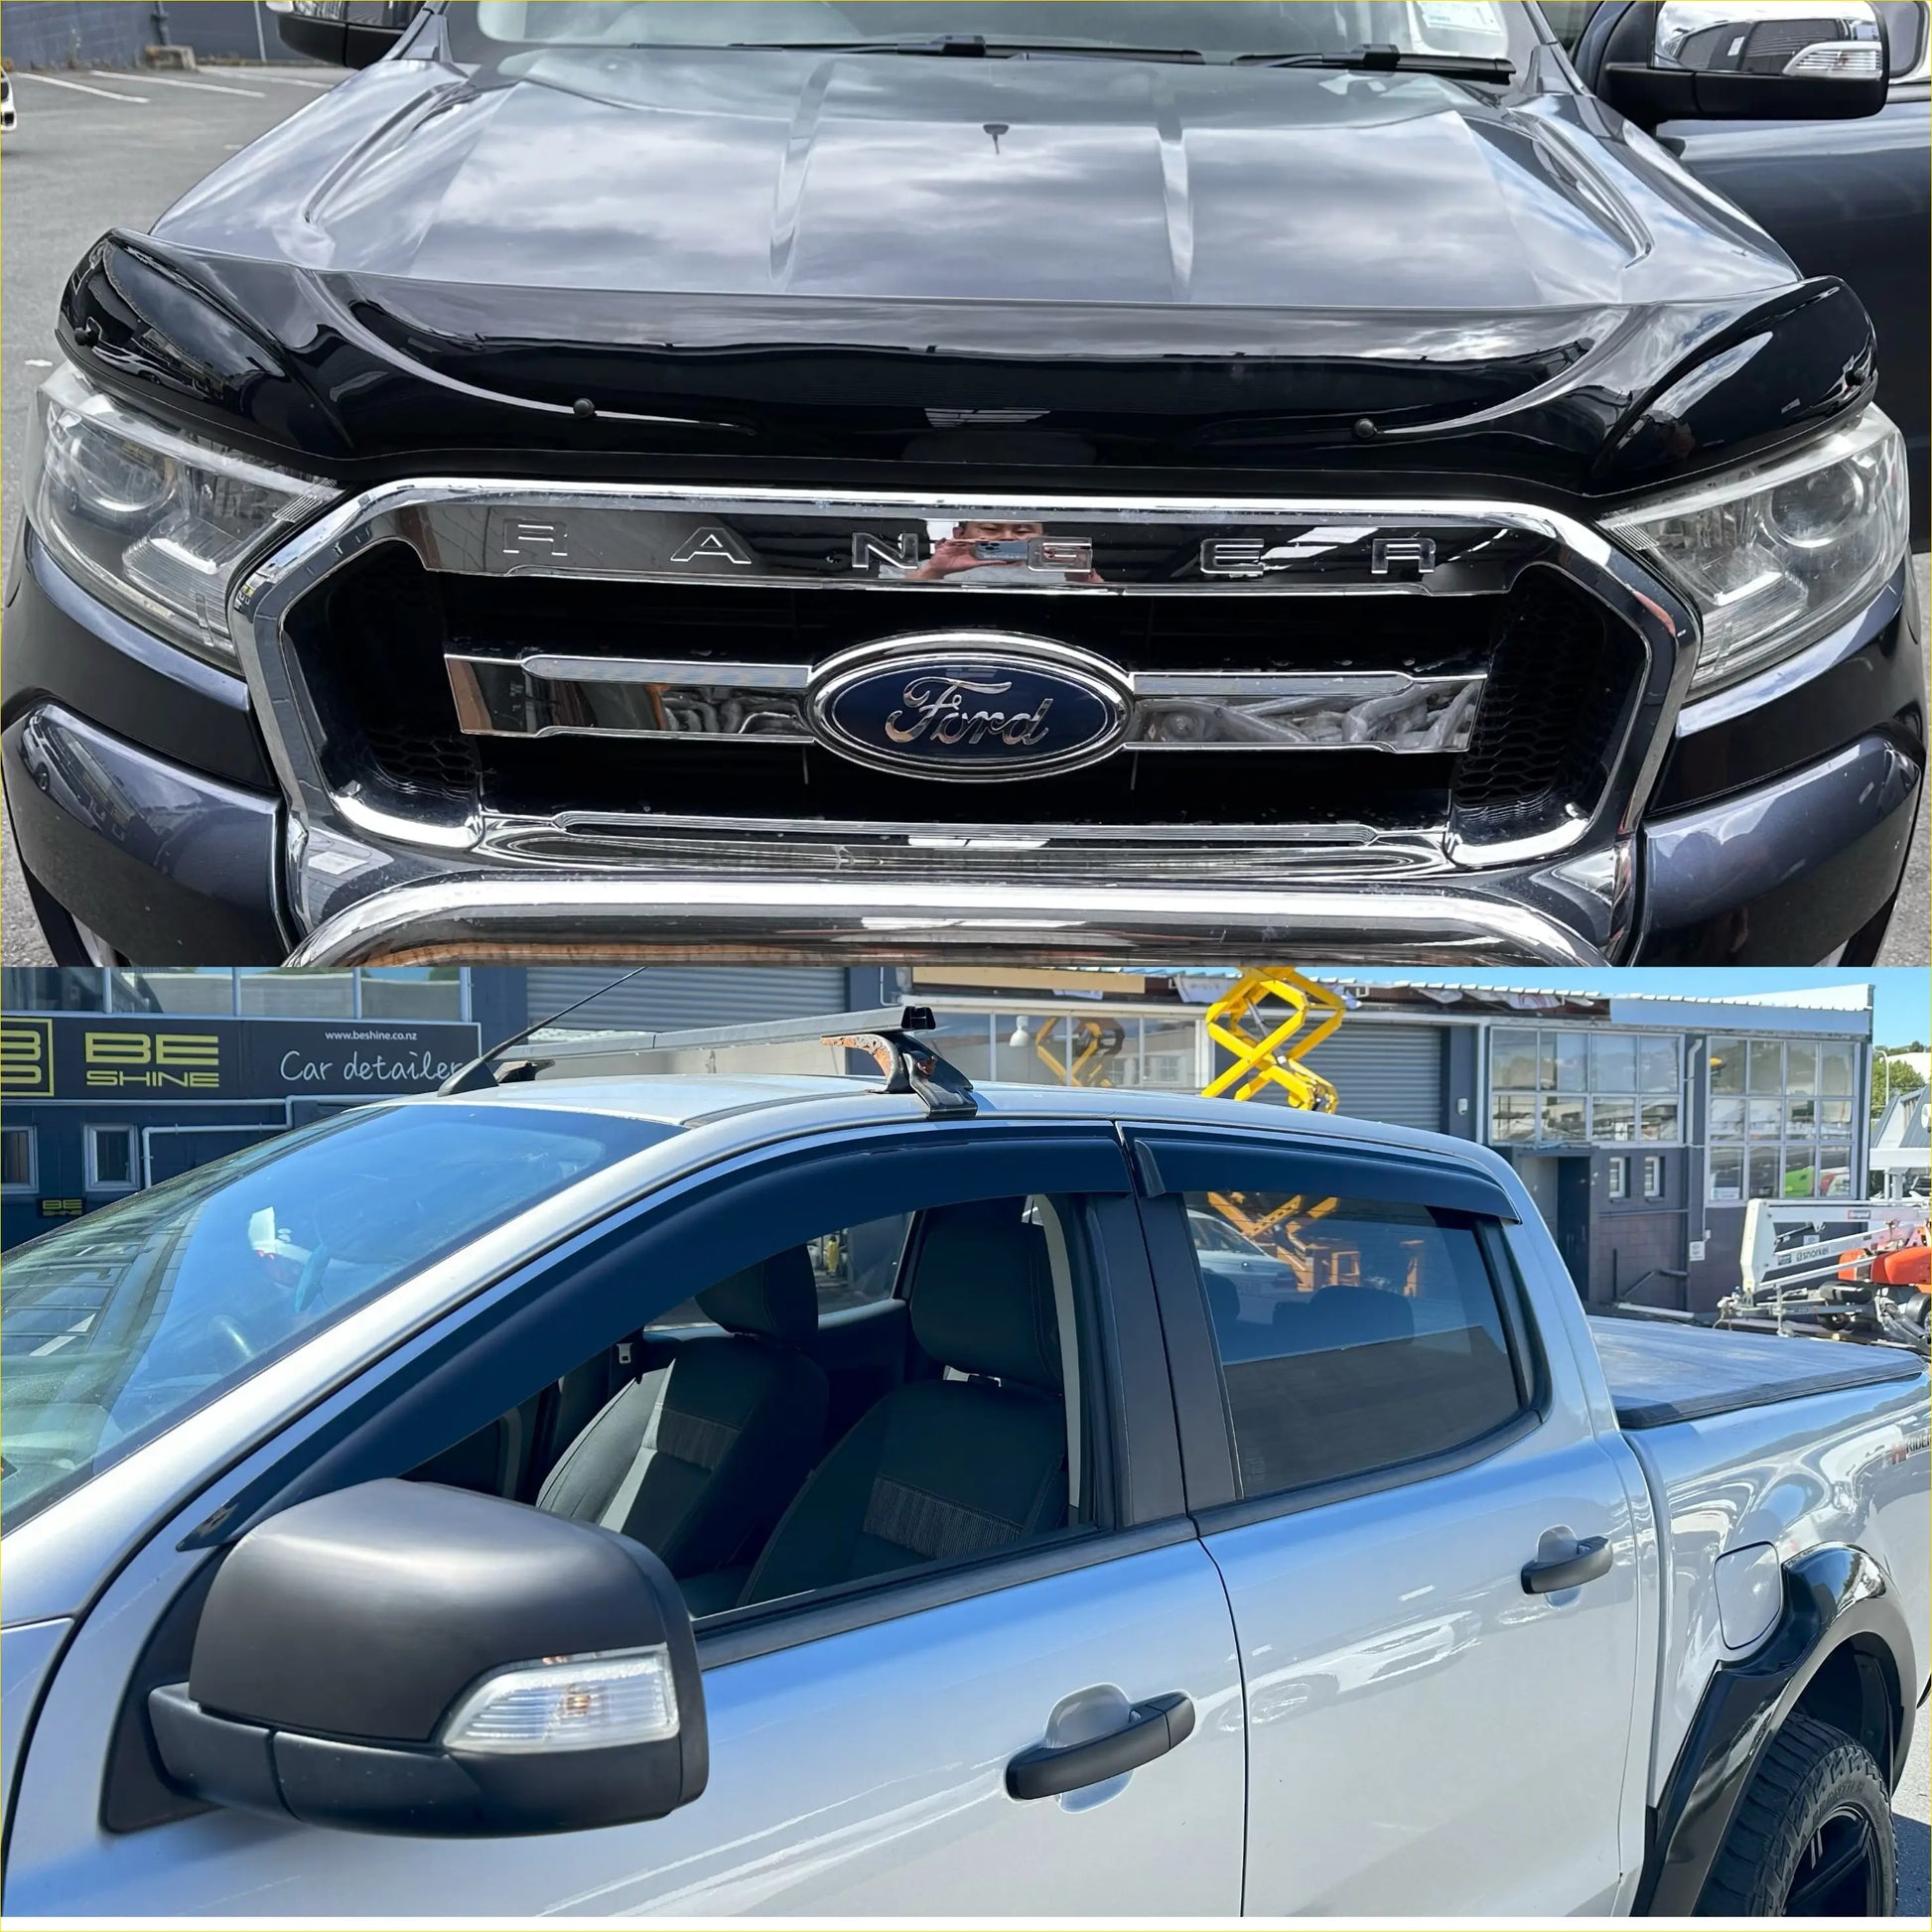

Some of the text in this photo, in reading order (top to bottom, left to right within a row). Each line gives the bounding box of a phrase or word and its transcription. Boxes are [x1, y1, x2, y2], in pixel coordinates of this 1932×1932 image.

[502, 517, 1438, 577] RANGER
[885, 676, 1054, 746] Ford
[84, 1032, 219, 1065] BE
[325, 1030, 418, 1041] www.beshine.co.nz
[86, 1069, 219, 1088] SHINE
[280, 1050, 334, 1081] Car
[43, 1199, 82, 1210] BE
